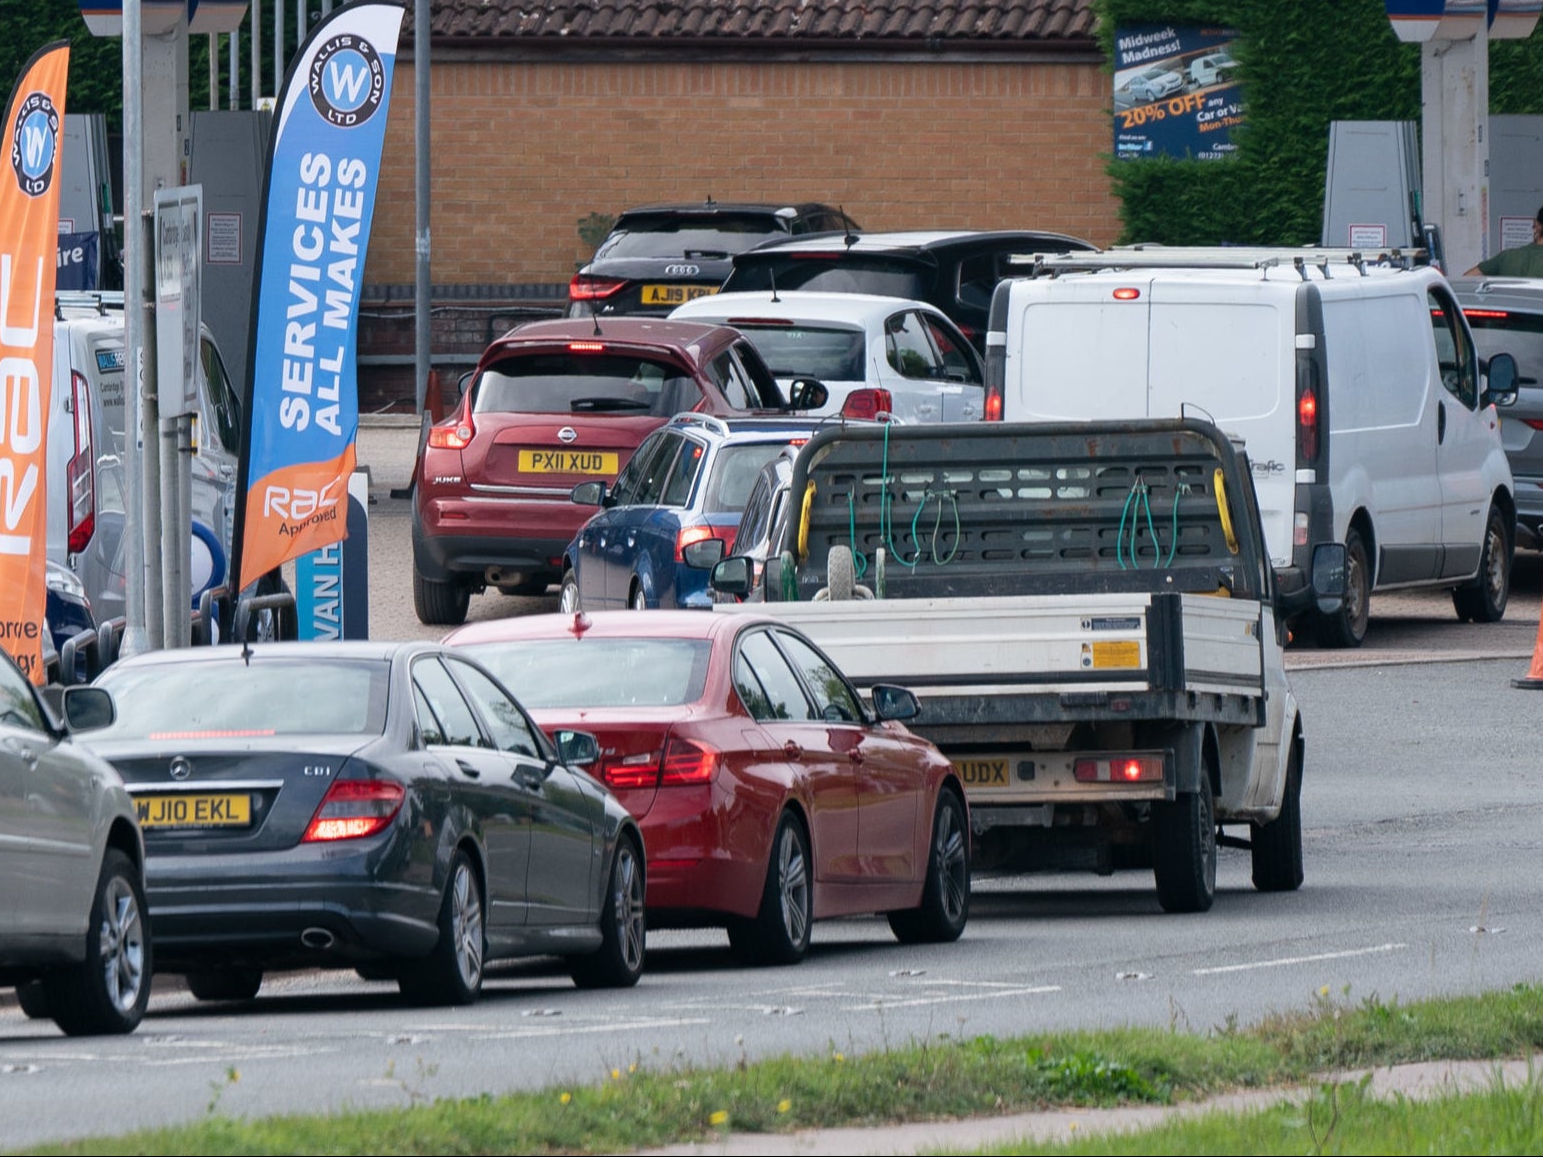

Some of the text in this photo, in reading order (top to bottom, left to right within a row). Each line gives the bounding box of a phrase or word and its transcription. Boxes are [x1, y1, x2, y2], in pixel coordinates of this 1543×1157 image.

[1118, 26, 1176, 50] Midweek
[1121, 39, 1181, 64] Madness!
[311, 37, 382, 125] WALLIS & SON LTD
[330, 60, 368, 103] W
[1120, 92, 1224, 129] 20% OFF any
[1197, 110, 1215, 122] Car
[1217, 108, 1229, 118] or
[1199, 116, 1247, 132] Mon-Thu
[58, 246, 84, 268] ire
[279, 152, 332, 432] SERVICES
[315, 157, 367, 436] ALL MAKES
[650, 287, 684, 301] AJ19
[531, 452, 603, 470] PX11 XUD
[433, 476, 462, 485] JUKE
[313, 575, 340, 642] VAN
[304, 766, 330, 776] CDI
[962, 761, 1005, 783] UDX
[194, 797, 240, 821] EKL
